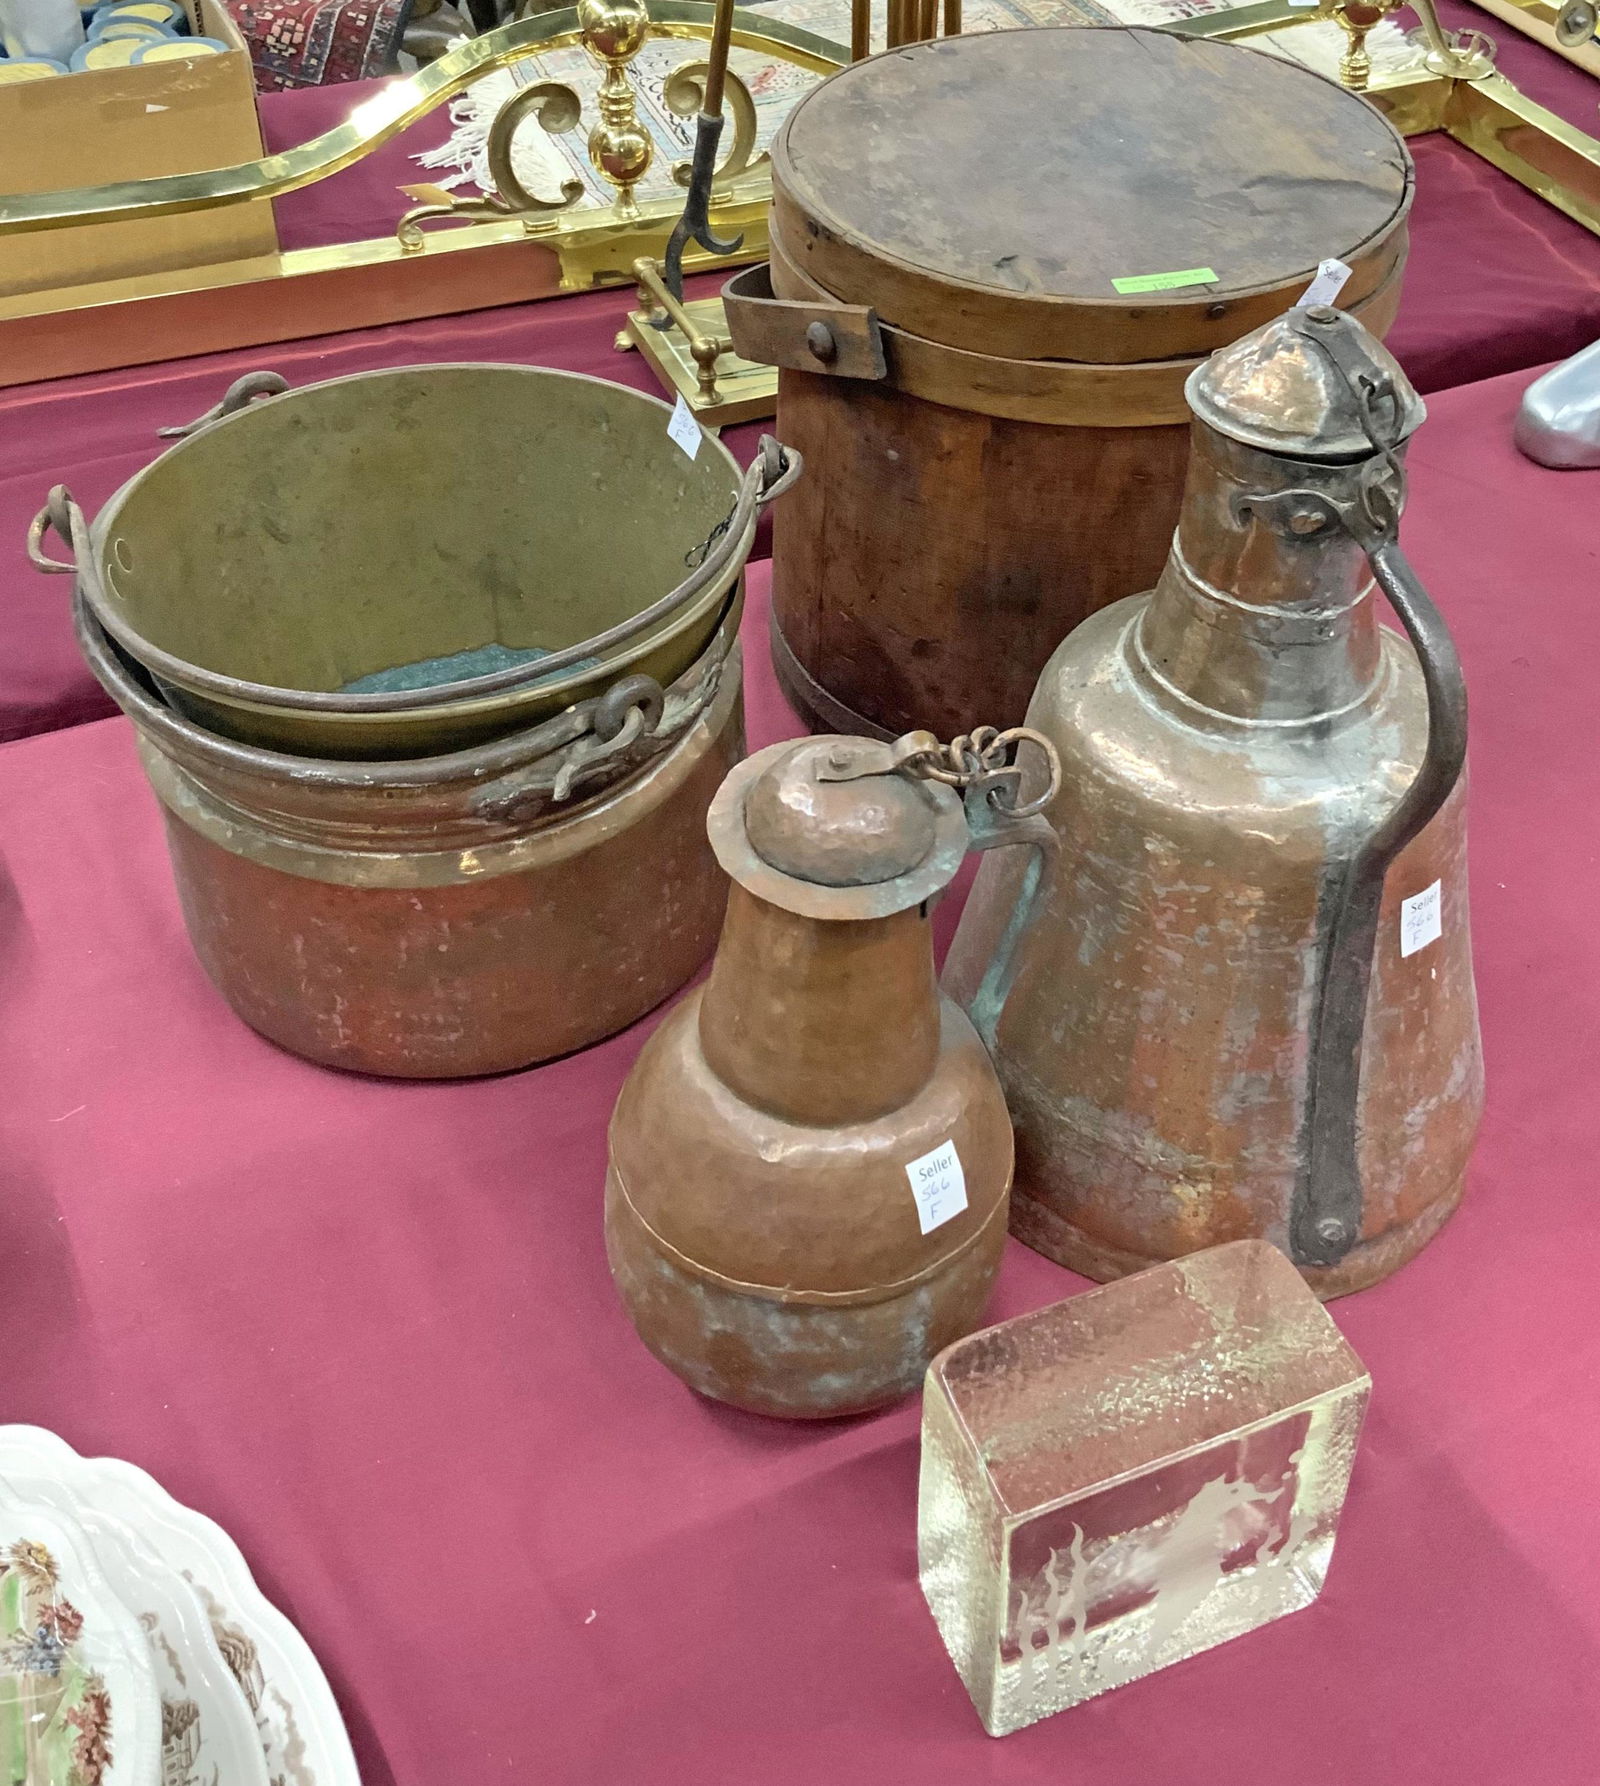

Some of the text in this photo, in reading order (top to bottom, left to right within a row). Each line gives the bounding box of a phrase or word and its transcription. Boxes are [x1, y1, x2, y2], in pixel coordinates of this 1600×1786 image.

[1410, 891, 1437, 914] Seller
[919, 1154, 953, 1182] Seller
[930, 1200, 943, 1220] F
